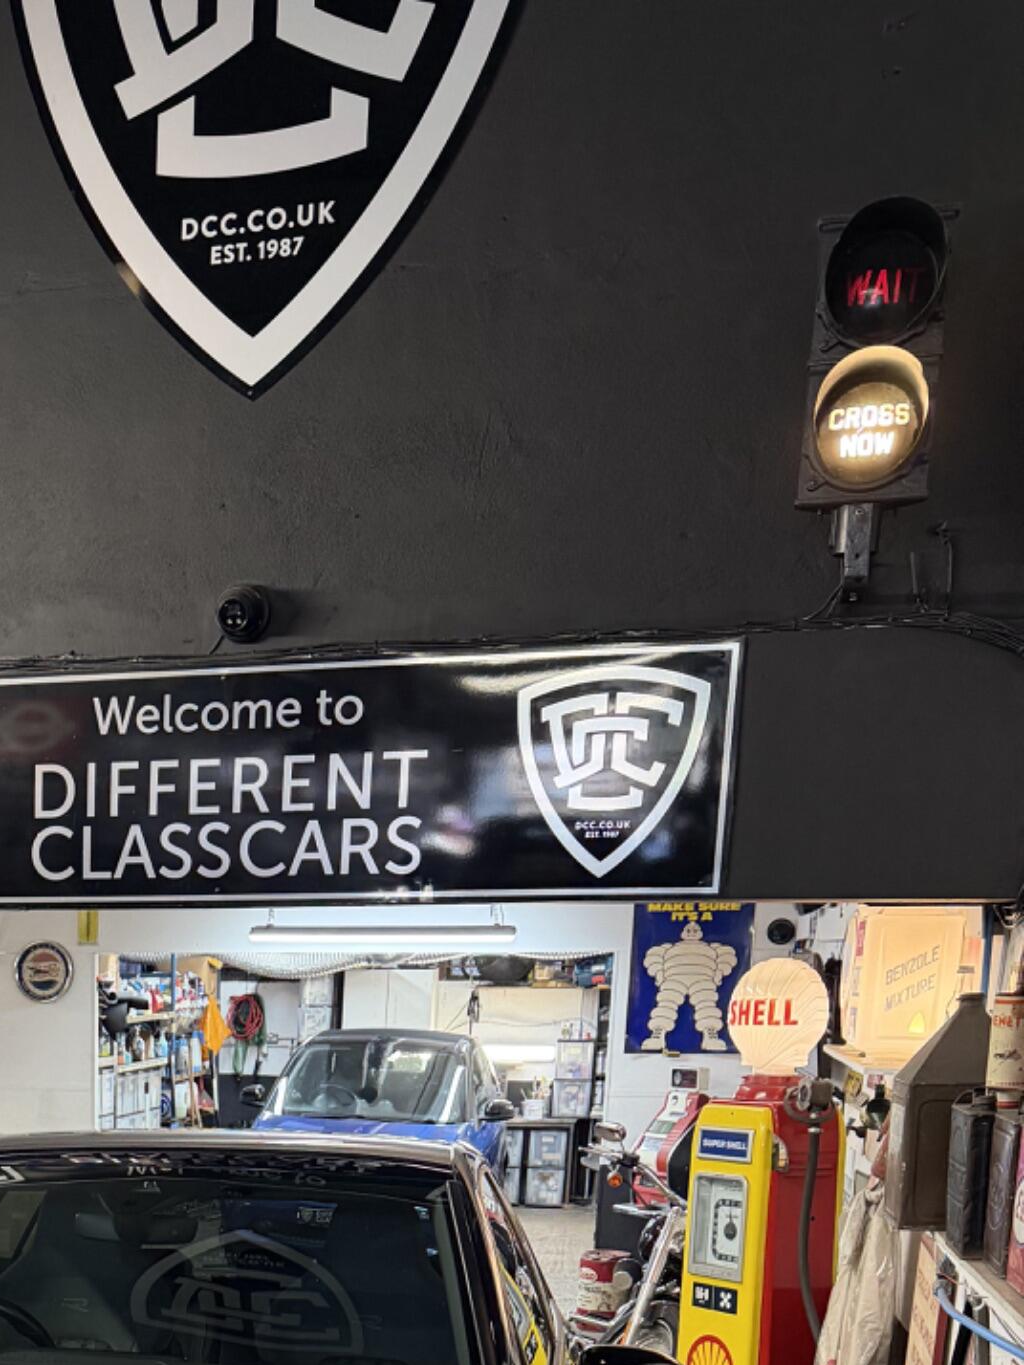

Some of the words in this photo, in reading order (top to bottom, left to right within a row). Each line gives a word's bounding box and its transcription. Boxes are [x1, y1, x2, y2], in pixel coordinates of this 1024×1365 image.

[180, 200, 336, 241] DCC.CO.UK
[209, 242, 252, 265] EST.
[257, 236, 304, 260] 1987
[847, 267, 924, 307] WAIT
[828, 402, 911, 431] CROSS
[839, 431, 896, 459] NOW
[93, 692, 300, 736] Welcome
[316, 689, 364, 727] to
[33, 748, 429, 820] DIFFERENT
[574, 820, 632, 830] DCC.CO.UK
[31, 816, 423, 881] CLASSCARS
[648, 902, 694, 912] MAKE
[699, 902, 741, 911] SURE
[671, 911, 698, 922] IT'S
[701, 911, 713, 921] A
[884, 944, 941, 986] BENZOLE
[729, 997, 799, 1028] SHELL
